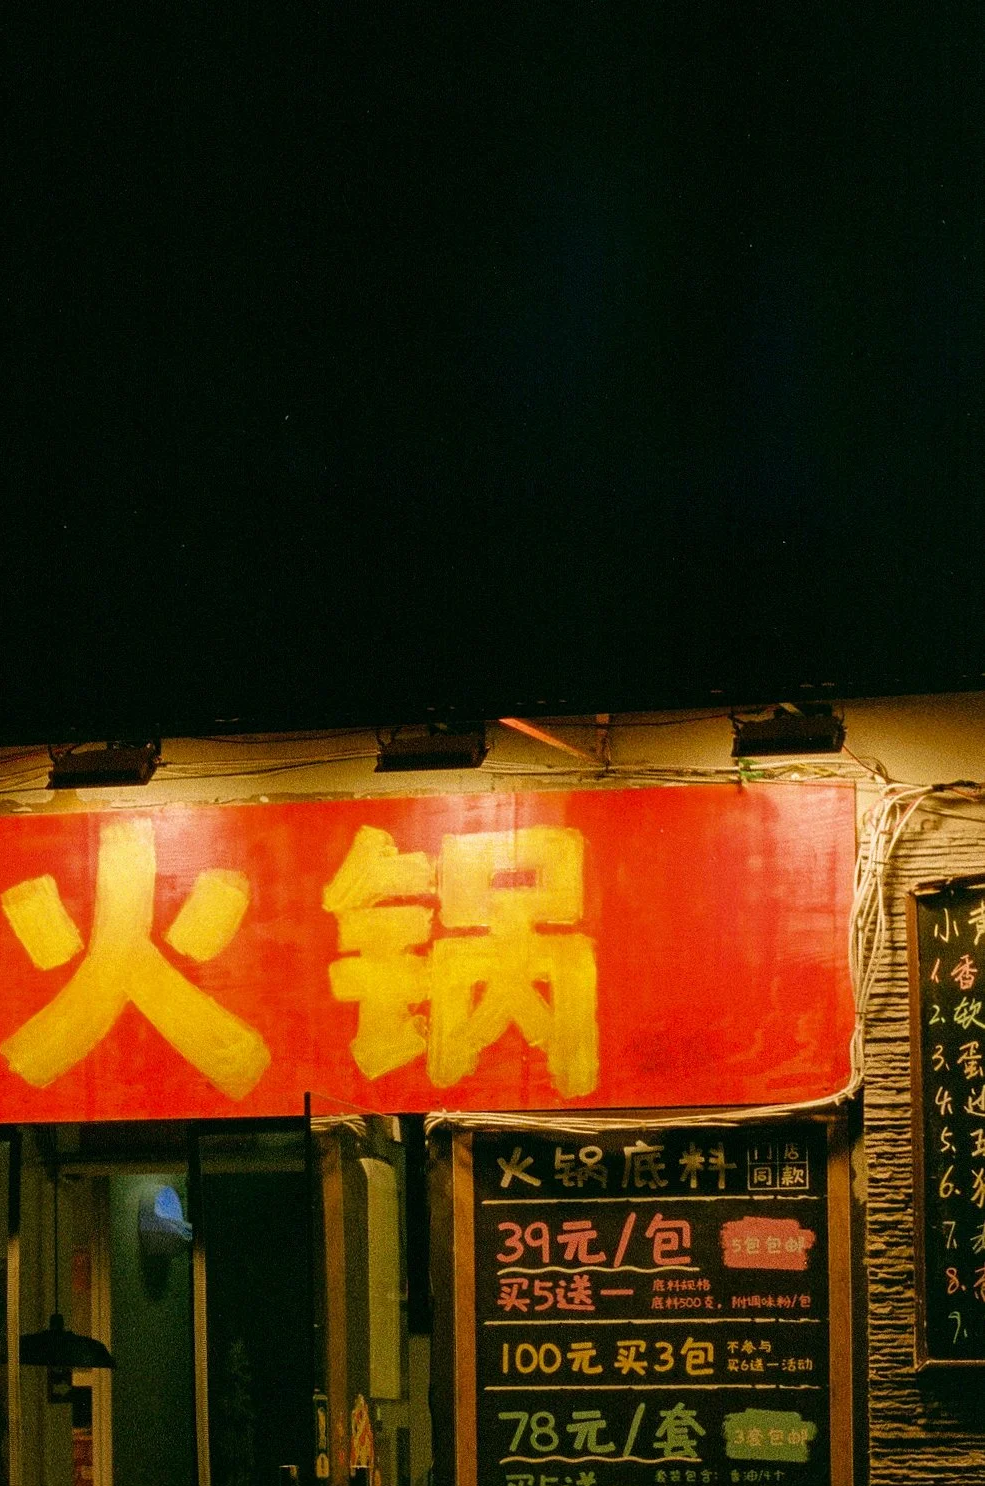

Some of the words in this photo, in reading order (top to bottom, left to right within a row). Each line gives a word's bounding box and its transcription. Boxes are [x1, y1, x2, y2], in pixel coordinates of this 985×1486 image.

[496, 1140, 737, 1190] 火锅底料
[753, 1165, 805, 1187] 同款
[495, 1212, 692, 1268] 39元/包
[497, 1275, 635, 1312] 买5送一
[727, 1340, 772, 1354] 不参与
[727, 1359, 813, 1372] 买6送一活动
[498, 1402, 706, 1458] 78元/套
